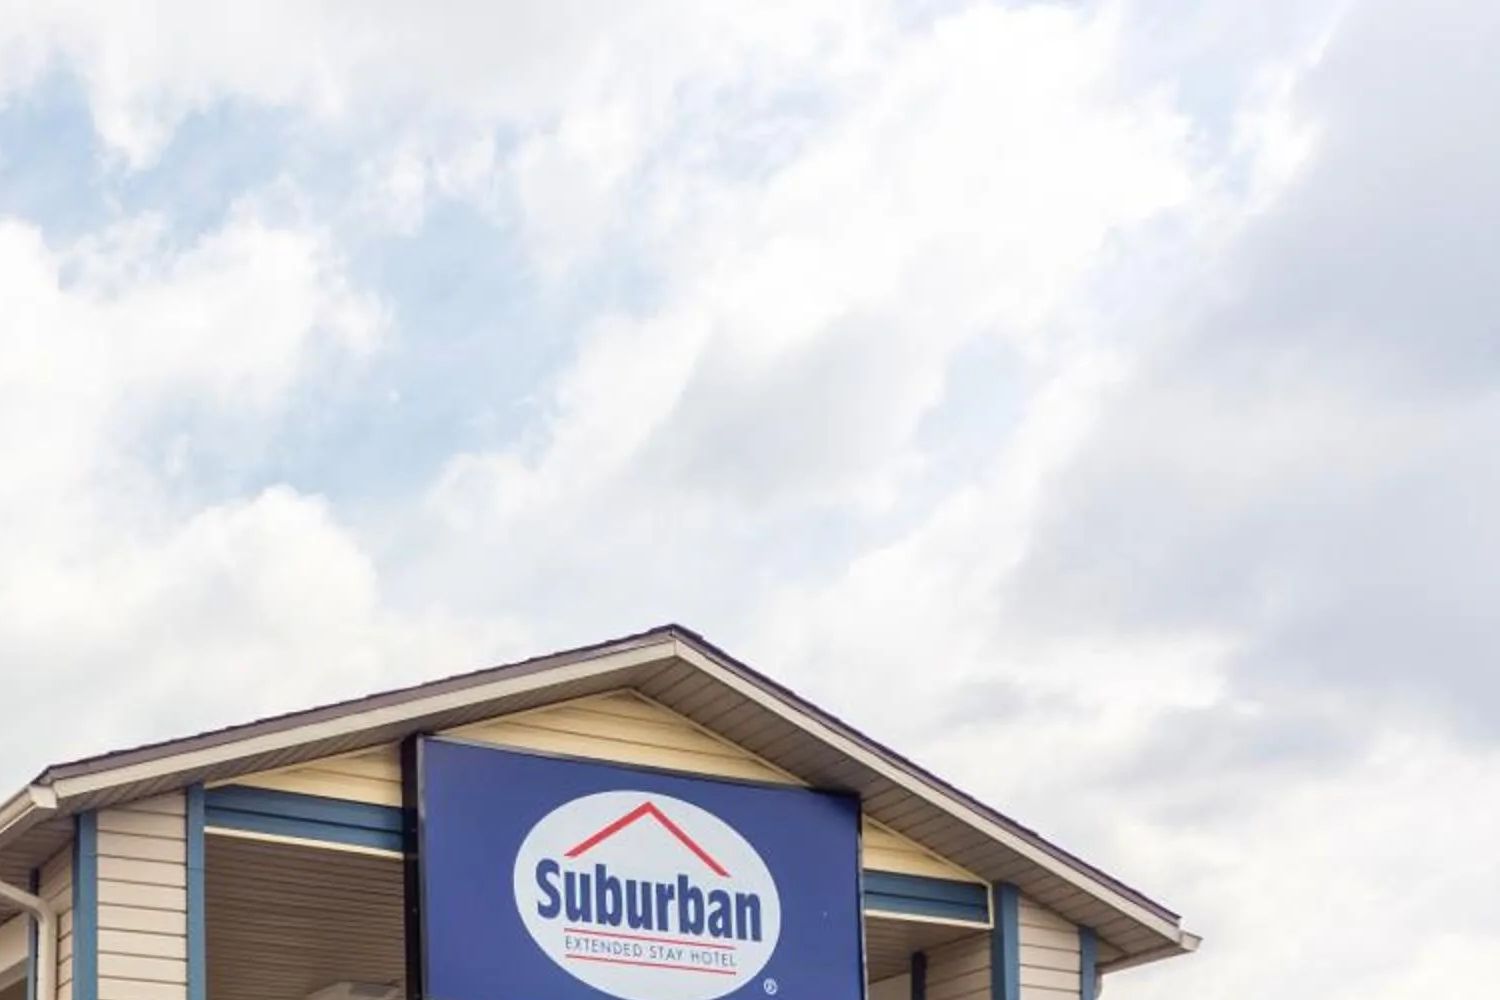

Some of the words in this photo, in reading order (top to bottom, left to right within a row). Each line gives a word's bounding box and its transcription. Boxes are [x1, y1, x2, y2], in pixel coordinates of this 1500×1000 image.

[535, 858, 762, 942] Suburban
[564, 936, 643, 958] EXTENDED
[649, 945, 684, 962] STAY
[690, 950, 737, 967] HOTEL
